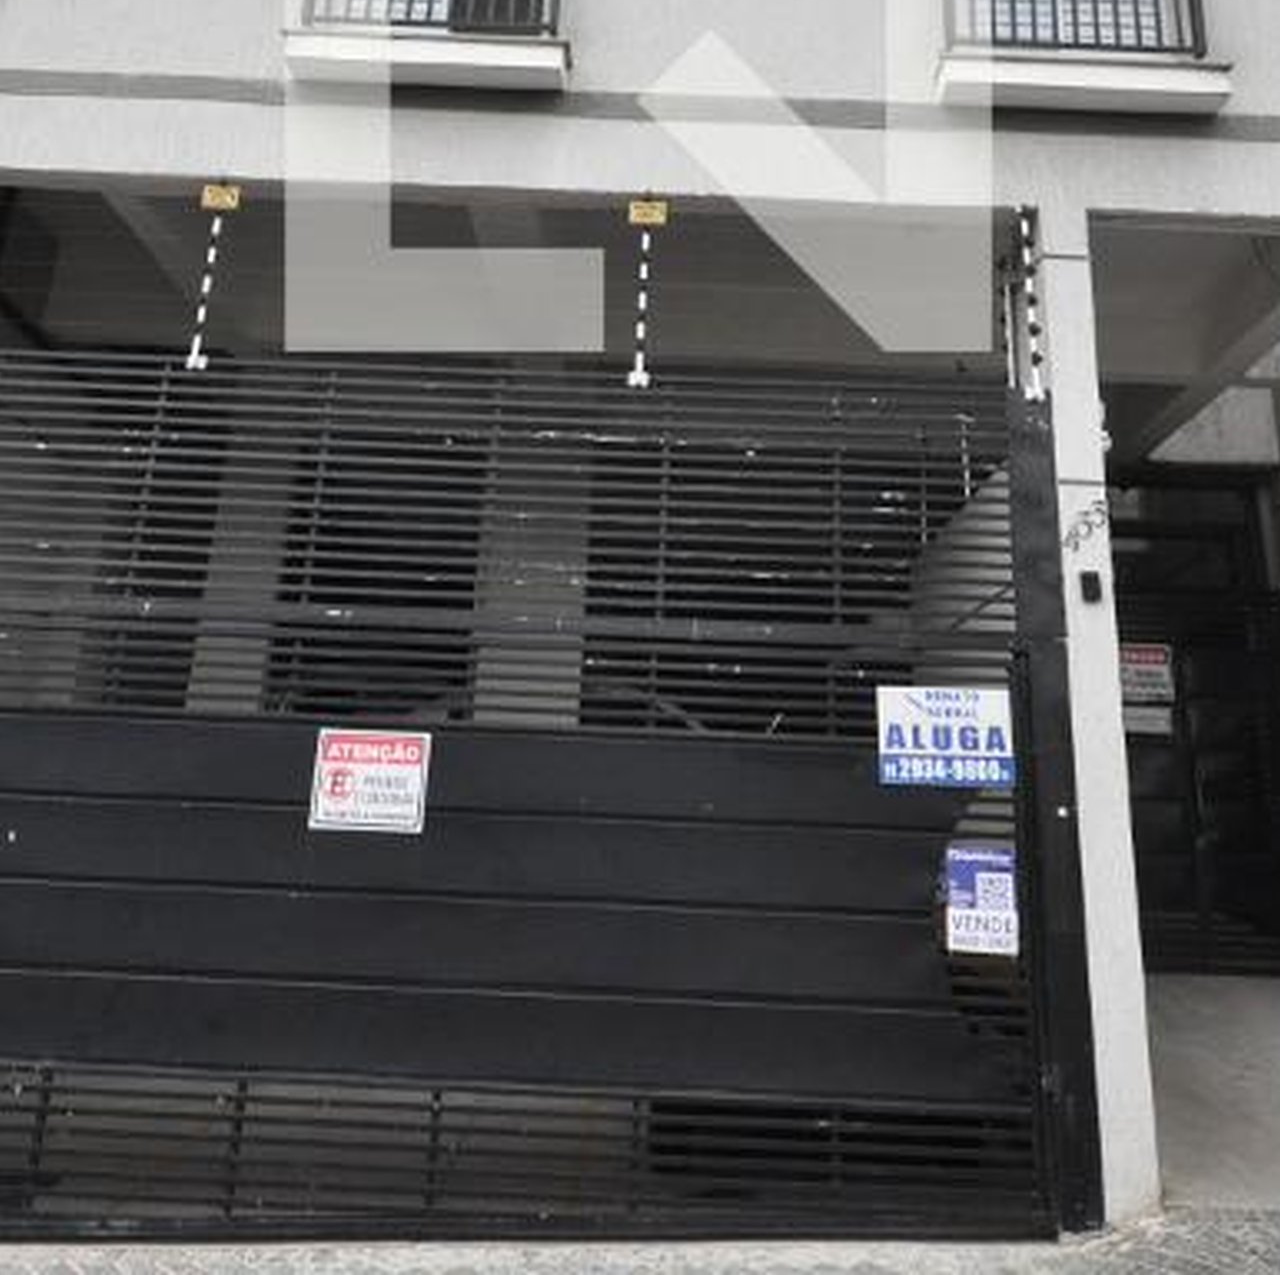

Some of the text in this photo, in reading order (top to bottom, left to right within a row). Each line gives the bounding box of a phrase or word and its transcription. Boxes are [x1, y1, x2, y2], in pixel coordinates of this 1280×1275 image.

[885, 723, 1006, 752] ALUGA
[326, 740, 420, 763] ATENÇÃO
[951, 914, 1014, 934] VENDE
